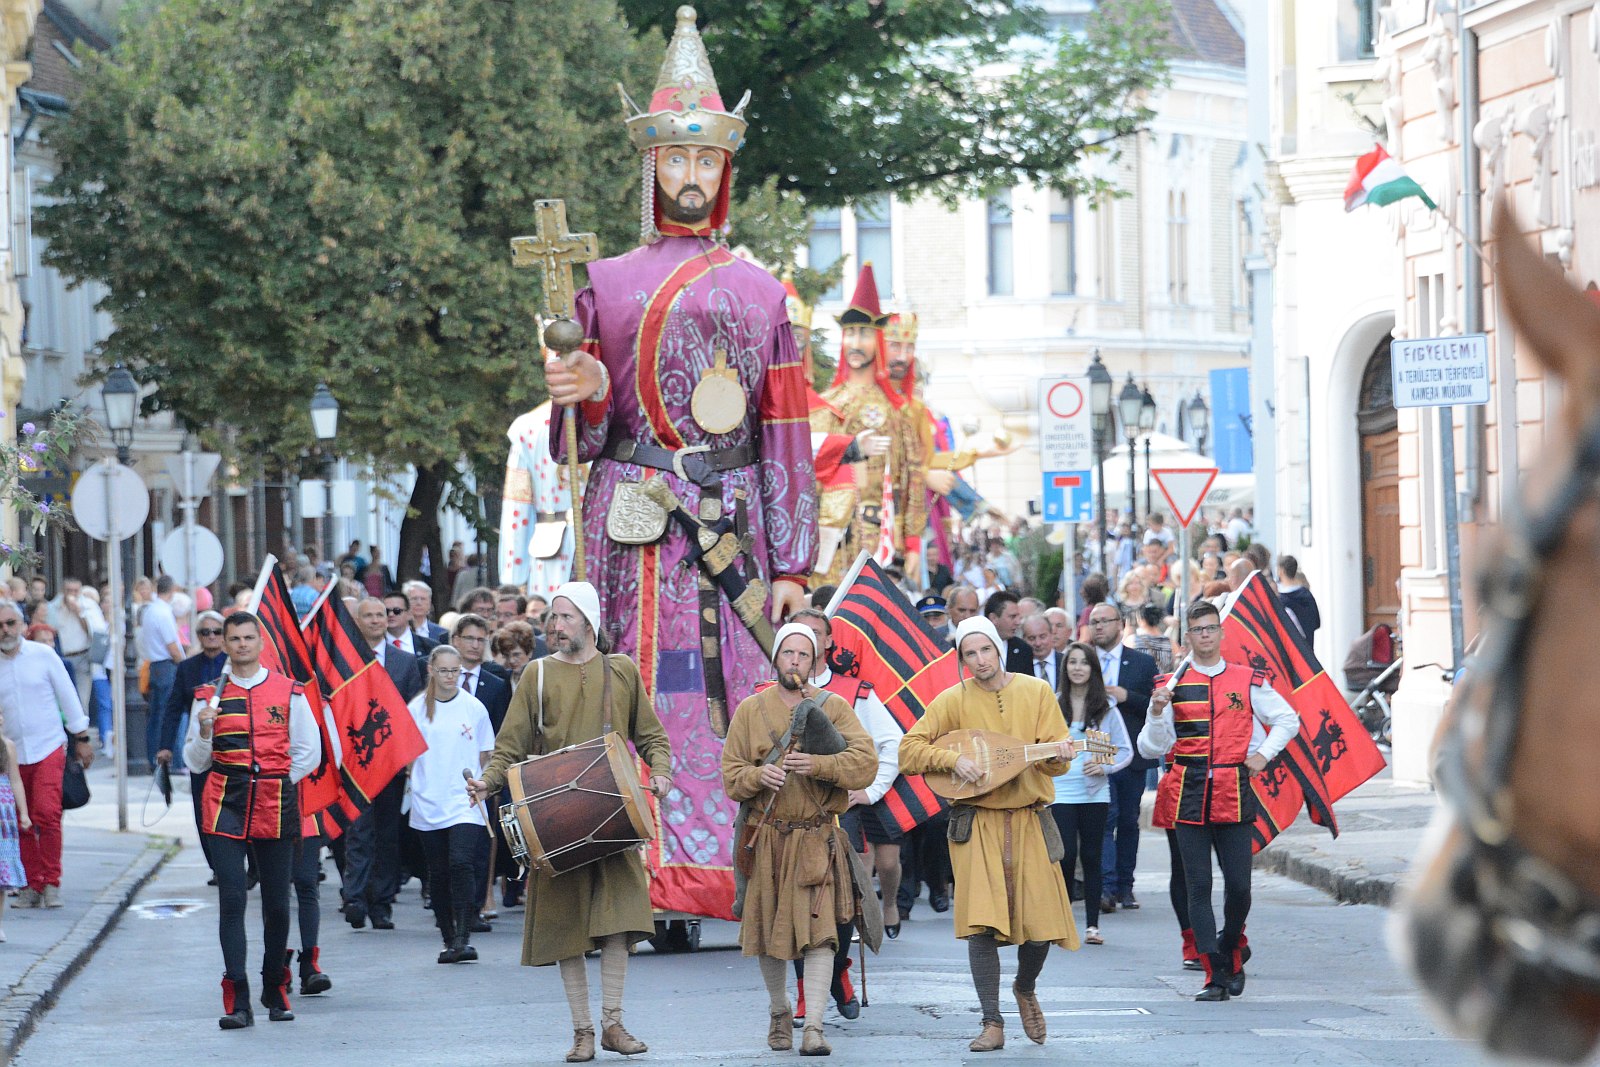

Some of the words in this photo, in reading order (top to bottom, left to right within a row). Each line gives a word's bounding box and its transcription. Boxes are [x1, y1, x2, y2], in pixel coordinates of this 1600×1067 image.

[1403, 343, 1477, 362] FIGYELEM!
[1405, 367, 1442, 383] TERÜLETEN
[1410, 386, 1439, 401] KAMERA
